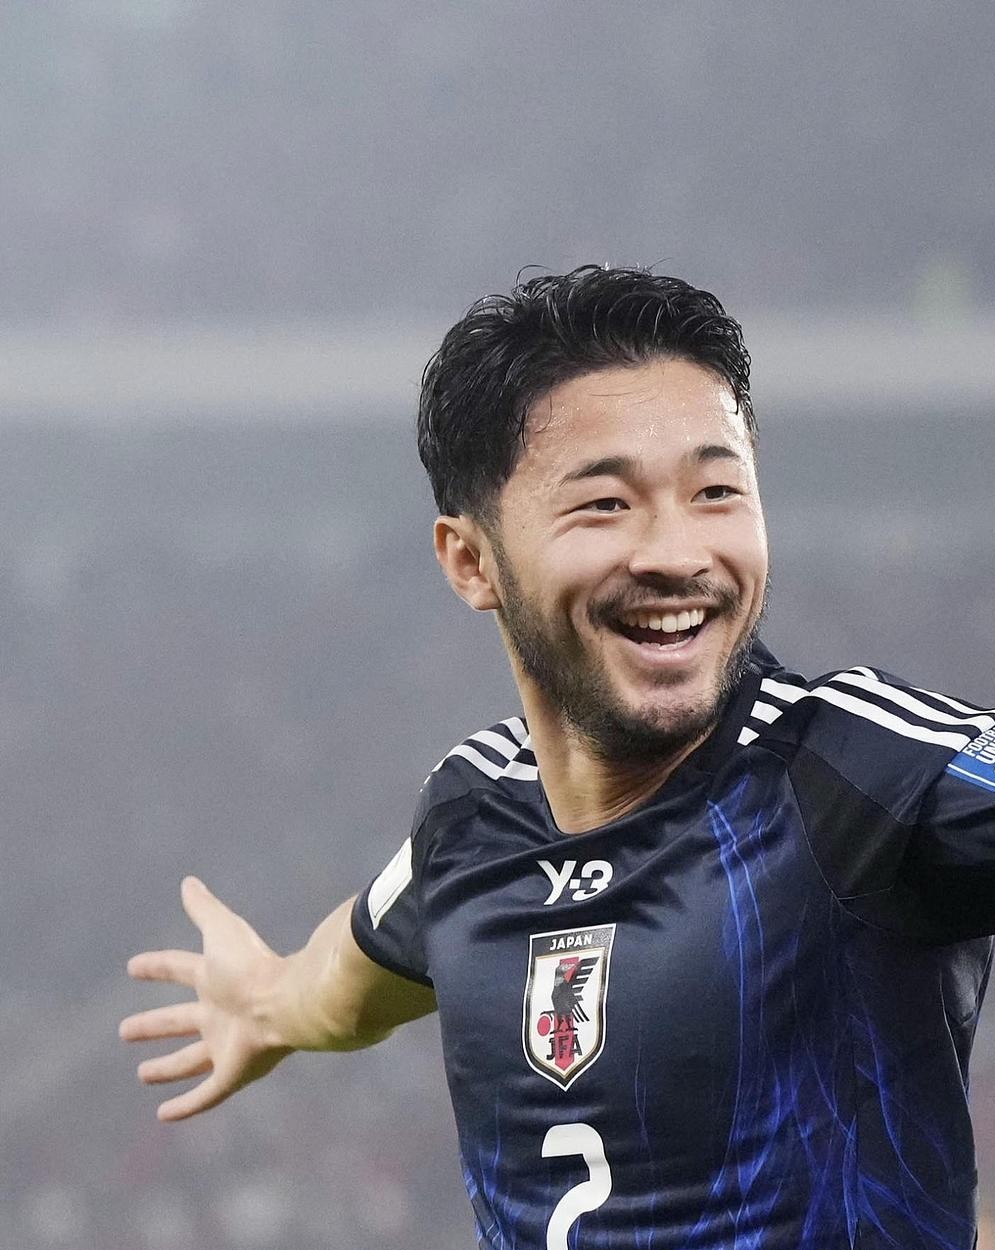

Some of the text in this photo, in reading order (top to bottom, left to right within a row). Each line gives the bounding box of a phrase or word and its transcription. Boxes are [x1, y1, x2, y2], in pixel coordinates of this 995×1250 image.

[537, 859, 614, 906] Y-3
[549, 933, 593, 951] JAPAN
[546, 1034, 583, 1061] JFA
